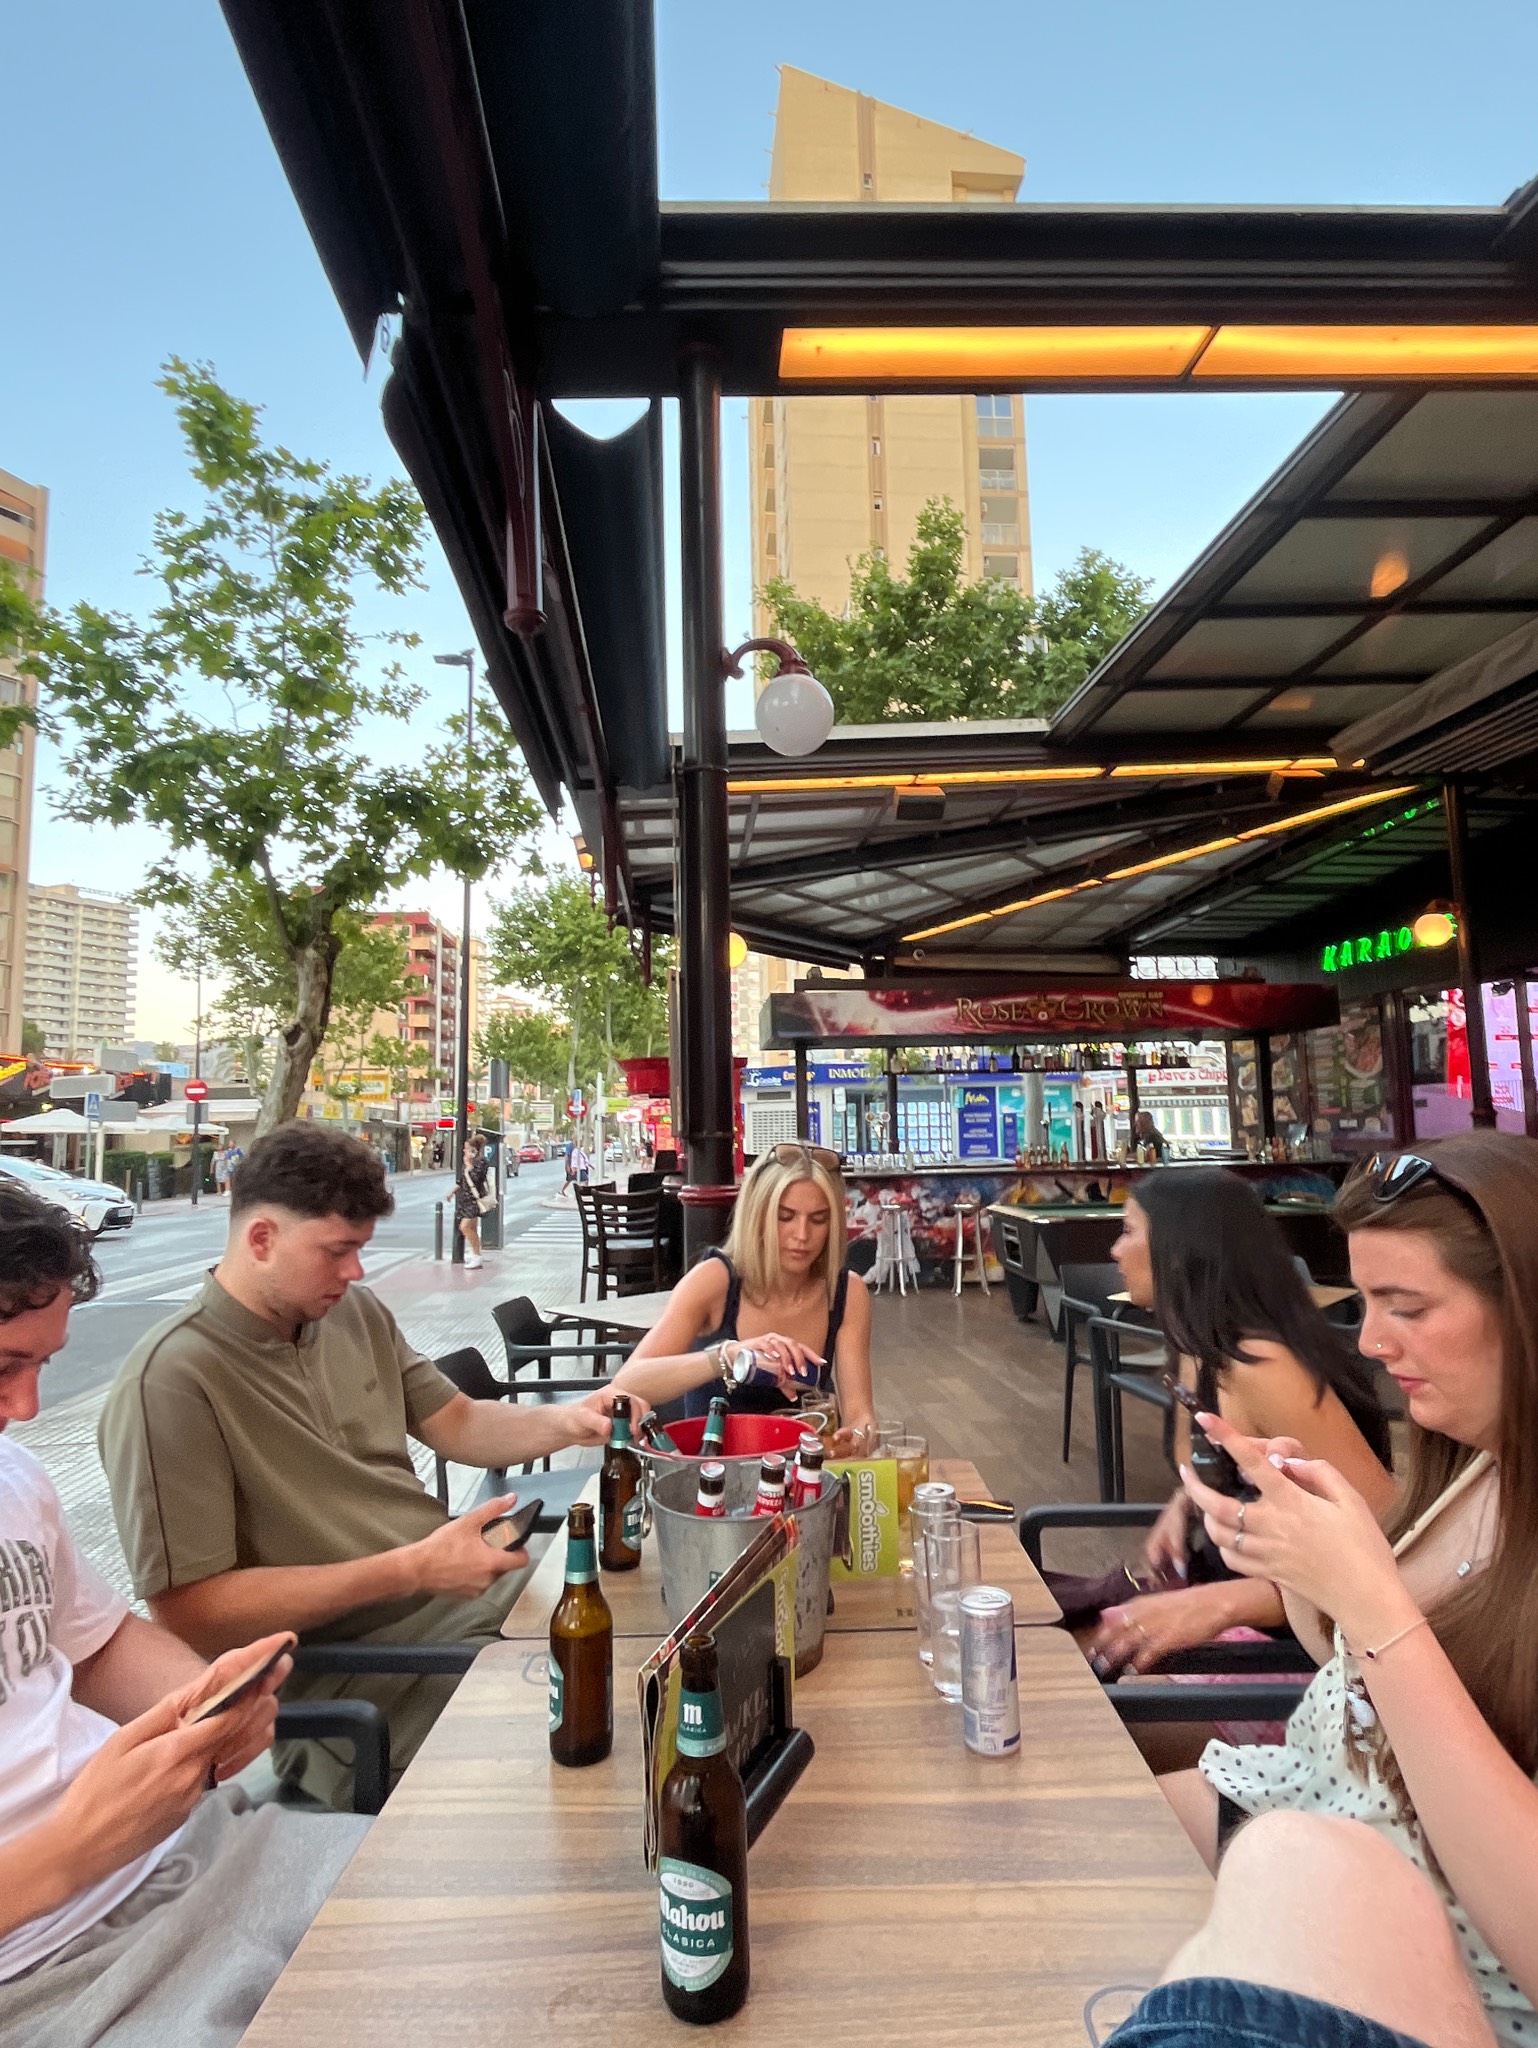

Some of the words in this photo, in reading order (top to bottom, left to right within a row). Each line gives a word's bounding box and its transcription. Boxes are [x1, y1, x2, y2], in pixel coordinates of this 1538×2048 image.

[1323, 913, 1458, 971] KARAO
[955, 997, 1025, 1029] ROSE
[1060, 998, 1164, 1024] CROWN
[1158, 1068, 1196, 1081] Dave's
[859, 1470, 881, 1573] smoothies
[683, 1703, 703, 1725] m
